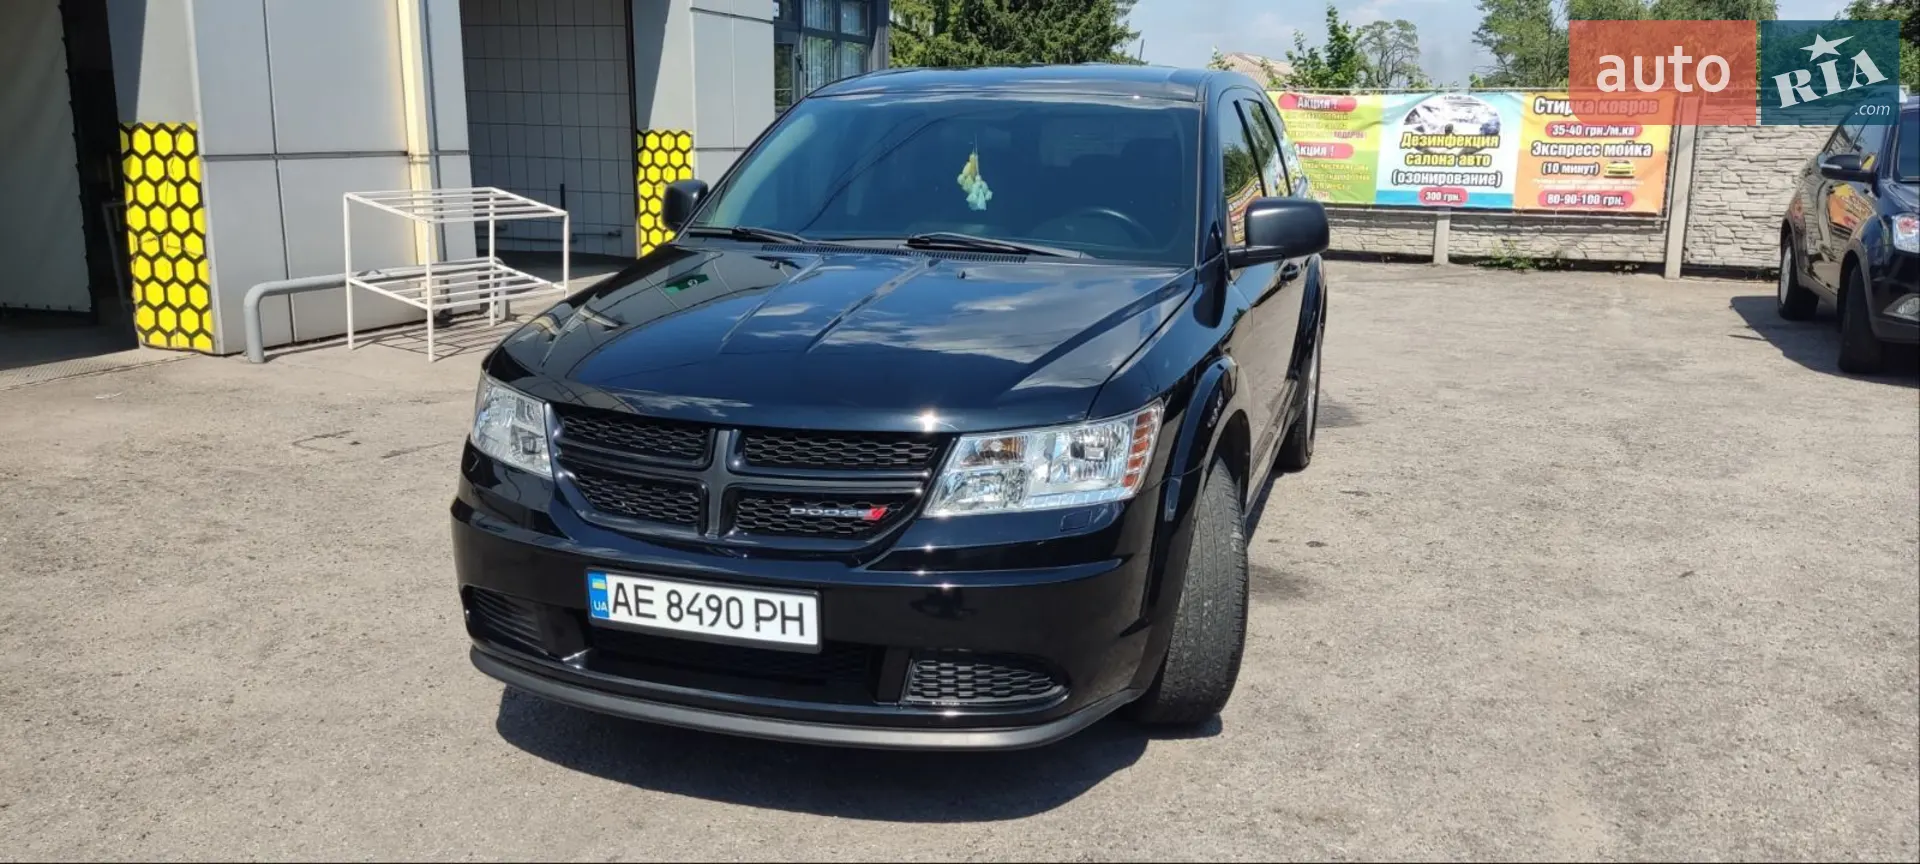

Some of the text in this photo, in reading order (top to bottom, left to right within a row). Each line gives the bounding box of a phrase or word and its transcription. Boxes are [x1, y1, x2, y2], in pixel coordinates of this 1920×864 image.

[1534, 97, 1659, 116] Стирка ковров
[1552, 124, 1582, 136] 35-40
[1401, 133, 1499, 149] Дезинфекция
[1531, 141, 1653, 157] Экспресс мойка
[1405, 153, 1492, 167] салона авто
[1542, 162, 1599, 175] (10 минут)
[1392, 169, 1503, 187] (озонирование)
[1425, 191, 1442, 201] 300
[593, 602, 609, 612] UA
[612, 582, 805, 637] AE 8490 PH
